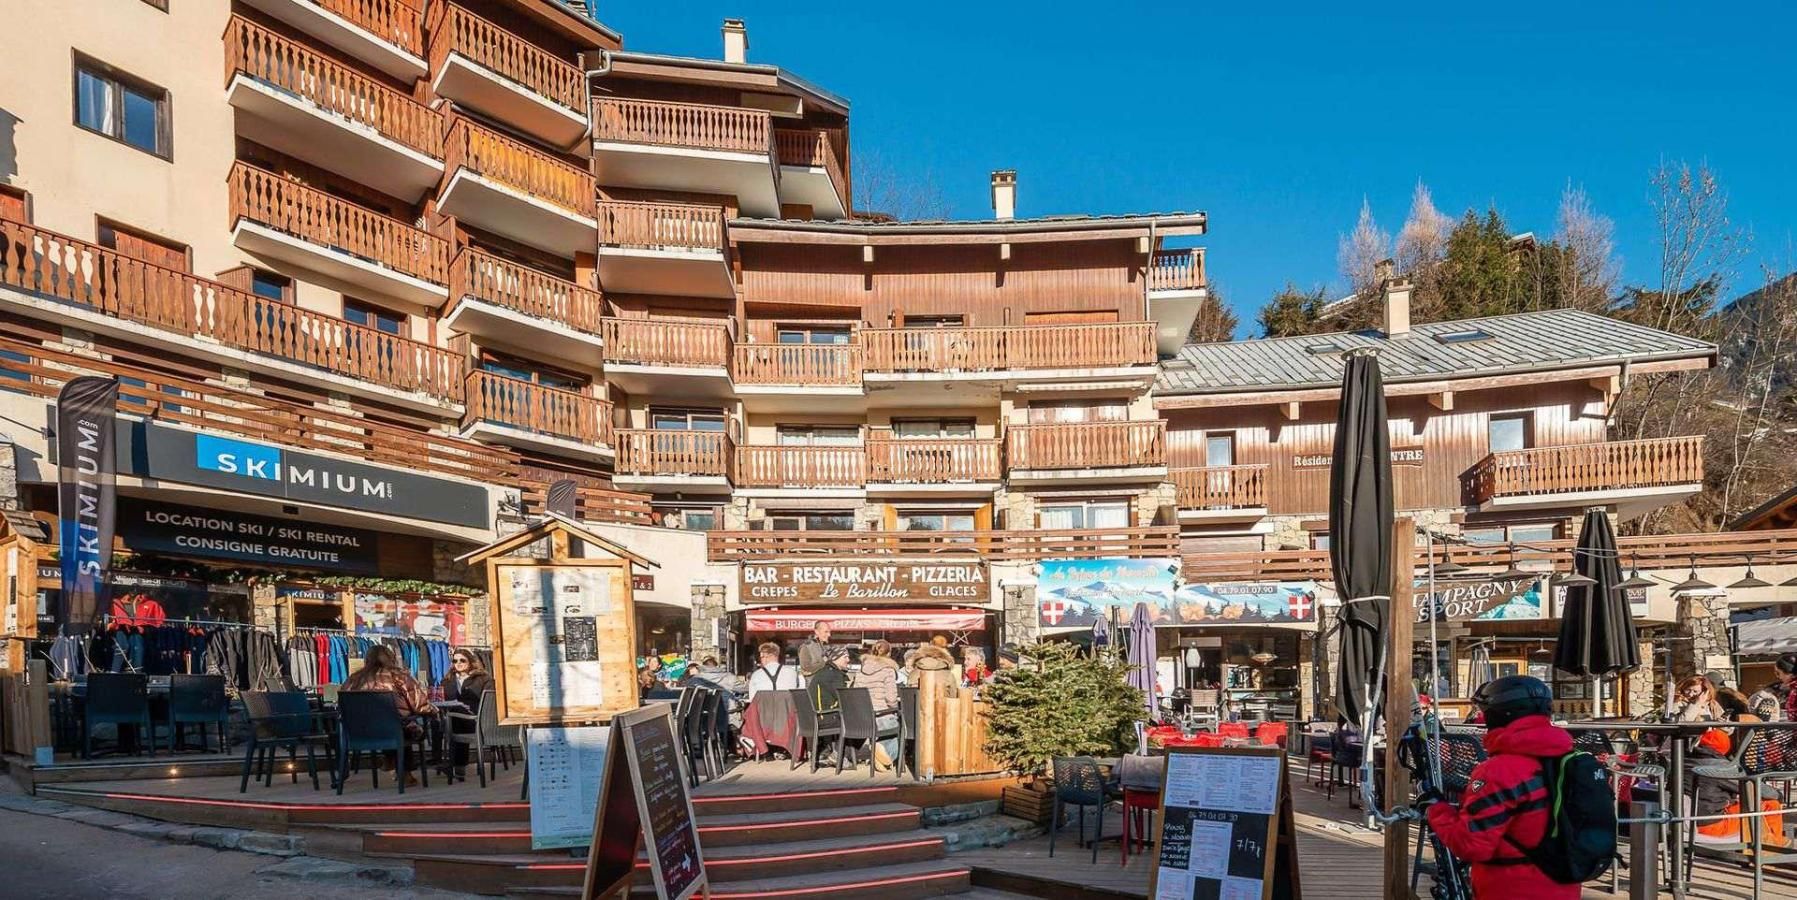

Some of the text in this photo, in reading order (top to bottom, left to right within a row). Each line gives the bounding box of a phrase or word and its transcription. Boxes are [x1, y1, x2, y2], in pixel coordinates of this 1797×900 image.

[1294, 450, 1424, 466] Résiden NTRE
[217, 453, 386, 499] SKIMIUM
[78, 426, 101, 578] SKIMIUM
[145, 510, 361, 547] LOCATION SKI / SKI RENTAL
[175, 535, 340, 562] CONSIGNE GRATUITE
[744, 566, 778, 583] BAR
[792, 566, 898, 584] RESTAURANT
[911, 566, 984, 583] PIZZERIA
[752, 583, 977, 598] CREPES Le Barillon GLACES
[1413, 580, 1522, 608] AMPAGNY
[1416, 598, 1490, 623] SPORT
[775, 620, 816, 630] BURGE
